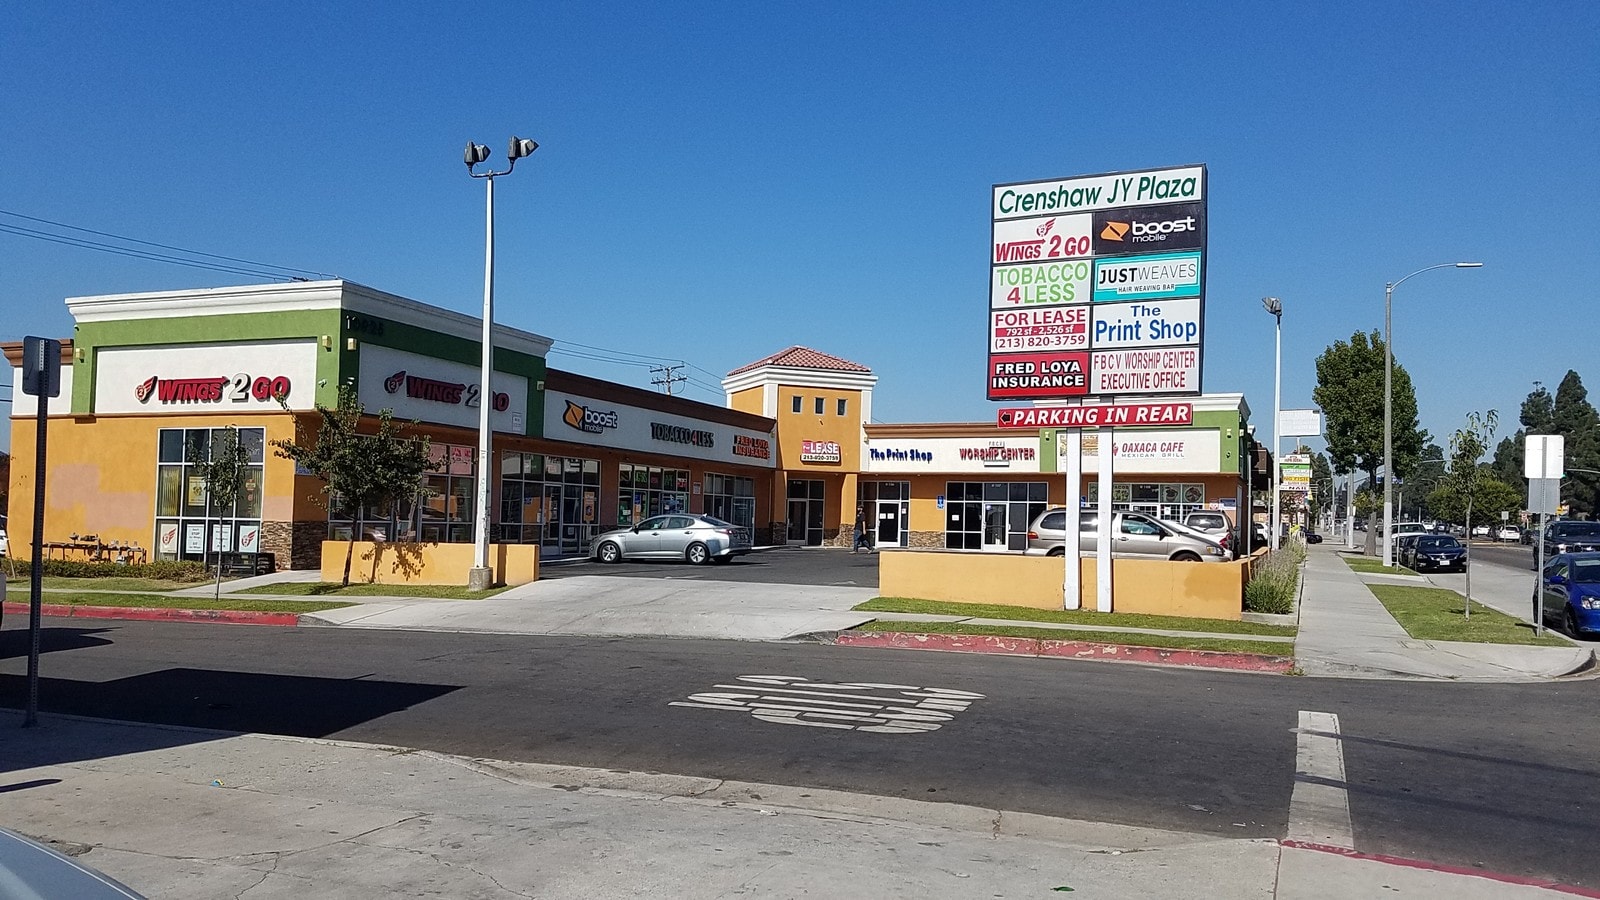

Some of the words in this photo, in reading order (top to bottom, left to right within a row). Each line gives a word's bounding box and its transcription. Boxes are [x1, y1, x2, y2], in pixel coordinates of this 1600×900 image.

[1000, 185, 1102, 214] Crenshaw
[1107, 177, 1134, 203] JY
[1137, 174, 1197, 201] Plaza
[1132, 216, 1196, 236] boost
[1048, 235, 1061, 257] 2
[1065, 236, 1090, 256] GO
[1132, 233, 1167, 243] mobile
[997, 262, 1088, 287] TOBACCO
[1134, 284, 1161, 292] WEAVING
[995, 312, 1029, 327] FOR
[1033, 309, 1086, 325] LEASE
[1130, 305, 1161, 317] The
[1006, 328, 1023, 336] 792
[1024, 327, 1032, 335] sf
[1038, 326, 1063, 336] 2,526
[1066, 325, 1074, 333] sf
[1096, 319, 1142, 342] Print
[1149, 319, 1197, 342] Shop
[995, 338, 1025, 350] (213)
[1028, 335, 1086, 347] 820-3759
[1125, 352, 1161, 369] WORSHIP
[1163, 350, 1196, 368] CENTER
[995, 362, 1036, 375] FRED
[1041, 361, 1081, 373] LOYA
[228, 373, 250, 401] 2
[252, 376, 290, 401] GO
[992, 375, 1085, 388] INSURANCE
[1101, 372, 1150, 390] EXECUTIVE
[1153, 371, 1186, 389] OFFICE
[493, 391, 510, 412] O
[584, 407, 618, 428] boost
[1013, 408, 1098, 425] PARKING
[1105, 407, 1128, 423] IN
[1136, 405, 1189, 423] REAR
[584, 423, 603, 433] mobile
[735, 445, 770, 459] INSURANCE
[810, 442, 839, 454] LEASE
[959, 447, 999, 461] WORSHIP
[1001, 447, 1036, 461] CENTER
[1121, 442, 1157, 453] OAXACA
[1160, 442, 1185, 453] CAFE
[870, 448, 885, 461] The
[886, 449, 908, 461] Print
[910, 449, 933, 464] Shop
